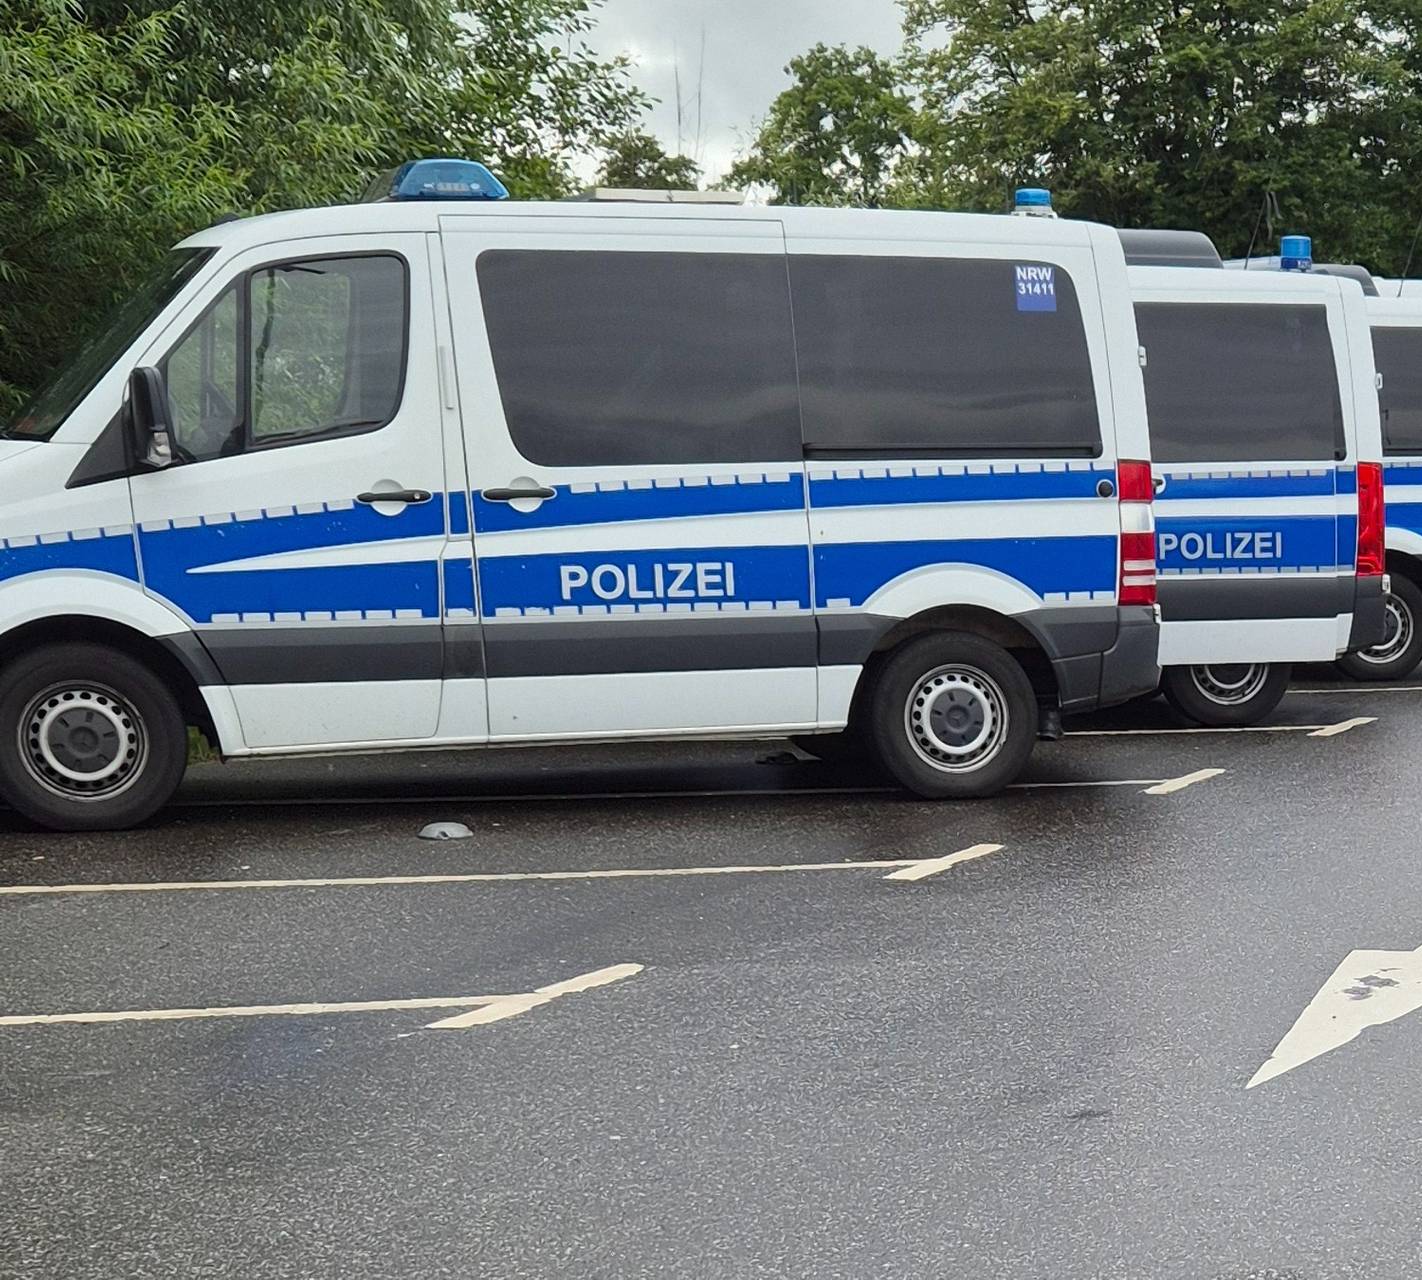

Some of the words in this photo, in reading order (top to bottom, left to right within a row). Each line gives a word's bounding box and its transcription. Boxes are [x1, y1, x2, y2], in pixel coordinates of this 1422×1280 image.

[1015, 266, 1052, 281] NRW
[1018, 282, 1054, 295] 31411
[1158, 532, 1282, 560] POLIZEI
[559, 562, 735, 601] POLIZEI
